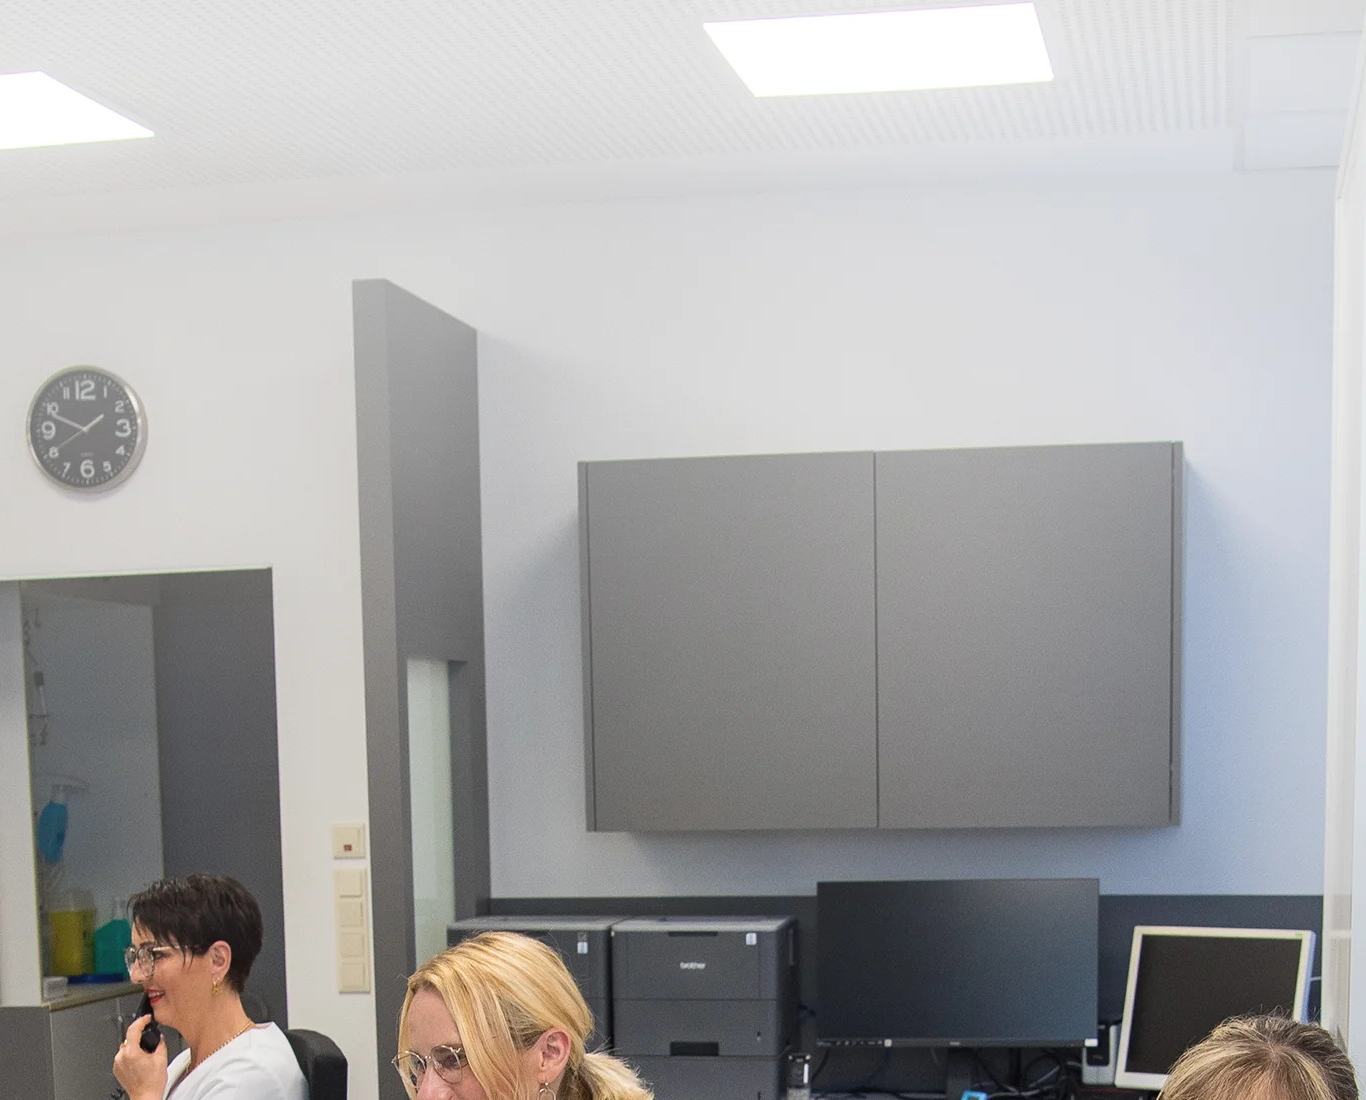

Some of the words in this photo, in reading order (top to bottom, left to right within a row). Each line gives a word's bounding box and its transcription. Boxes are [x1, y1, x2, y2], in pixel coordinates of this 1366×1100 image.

[75, 380, 96, 400] 12
[103, 385, 108, 399] 1
[115, 400, 124, 413] 2
[41, 421, 56, 440] 9
[115, 419, 131, 437] 3
[49, 446, 59, 459] 8
[115, 445, 125, 456] 4
[63, 461, 71, 478] 7
[80, 459, 95, 478] 6
[102, 461, 112, 472] 5
